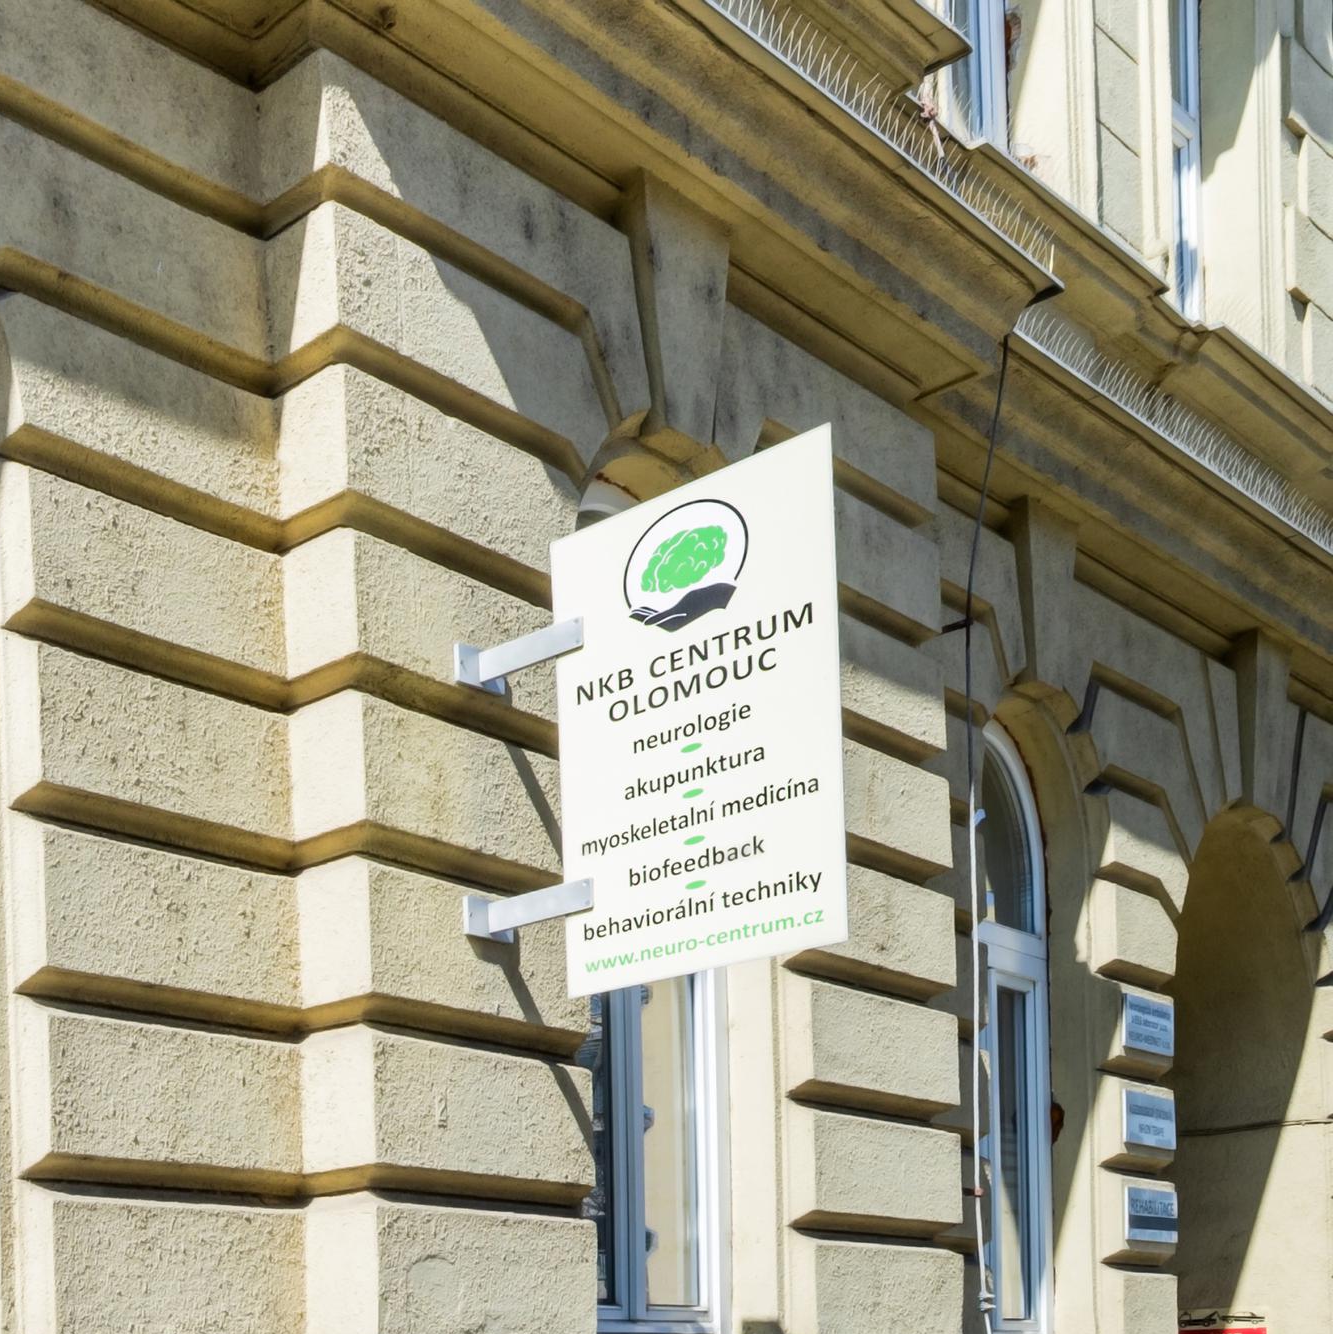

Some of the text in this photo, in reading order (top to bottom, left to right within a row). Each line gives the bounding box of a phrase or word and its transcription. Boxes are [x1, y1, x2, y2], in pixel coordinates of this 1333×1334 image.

[576, 601, 813, 706] NKB CENTRUM
[608, 647, 777, 723] OLOMOUC
[633, 702, 752, 755] neurologie
[624, 746, 765, 801] akupunktura
[581, 777, 819, 857] myoskeletalní medicína
[628, 835, 765, 888] biofeedback
[583, 870, 823, 942] behaviorální techniky
[585, 909, 824, 973] www.neuro-centrum.cz
